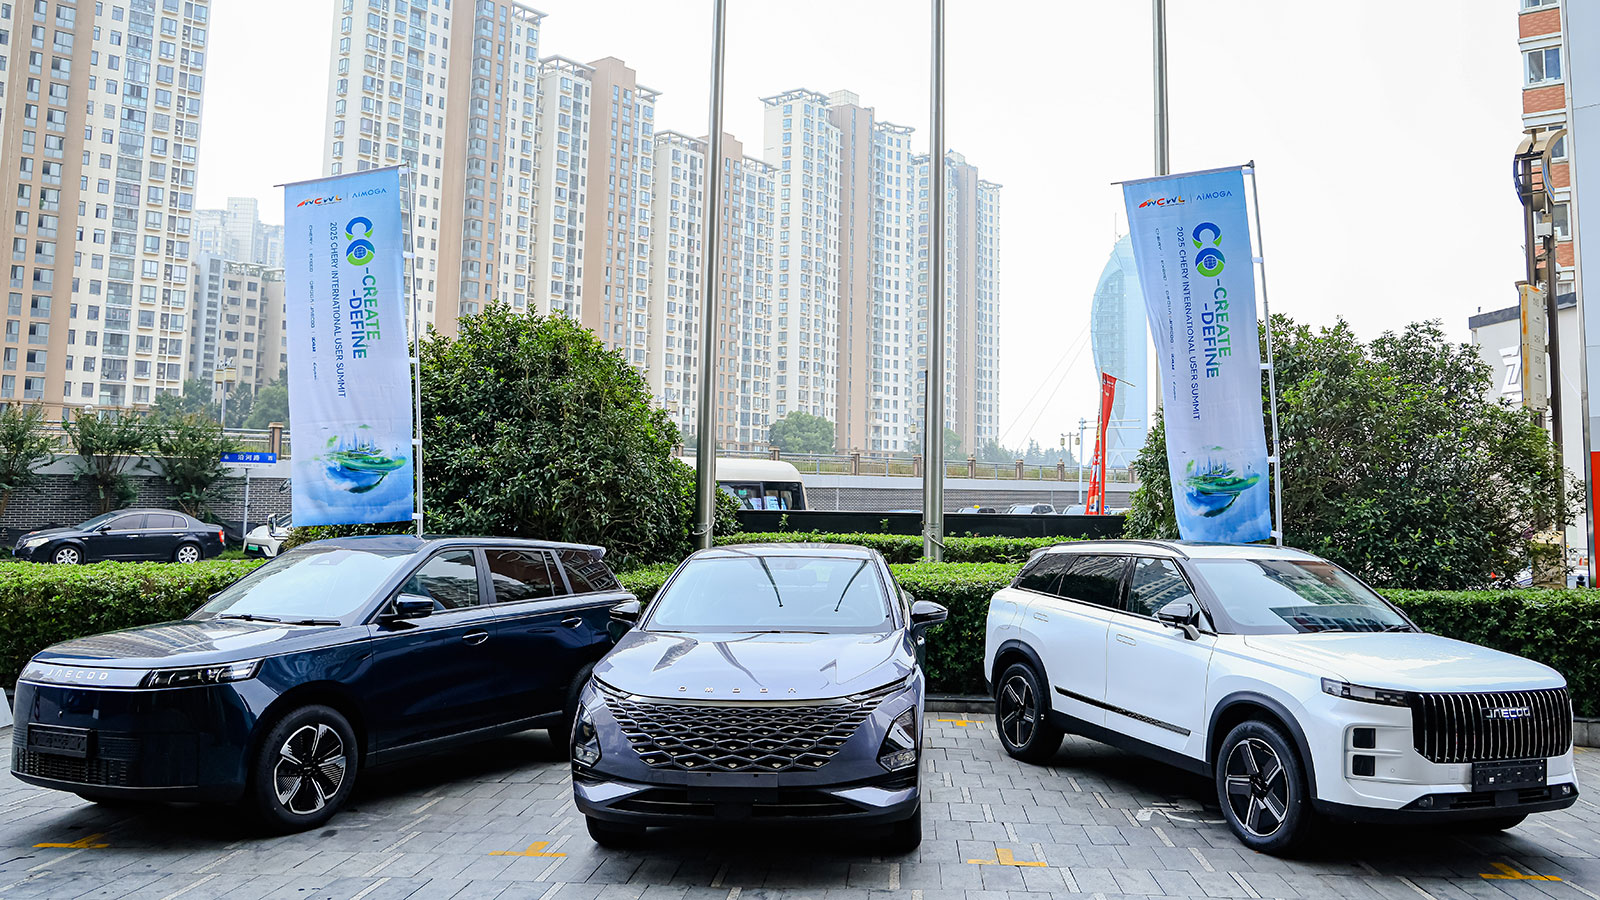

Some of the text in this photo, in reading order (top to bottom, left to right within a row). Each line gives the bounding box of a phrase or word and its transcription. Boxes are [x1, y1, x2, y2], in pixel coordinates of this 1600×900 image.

[329, 222, 346, 397] 2025 CHERY INTERNATIONAL USER SUMMIT
[1176, 226, 1200, 420] 2025 CHERY INTERNATIONAL USER SUMMIT
